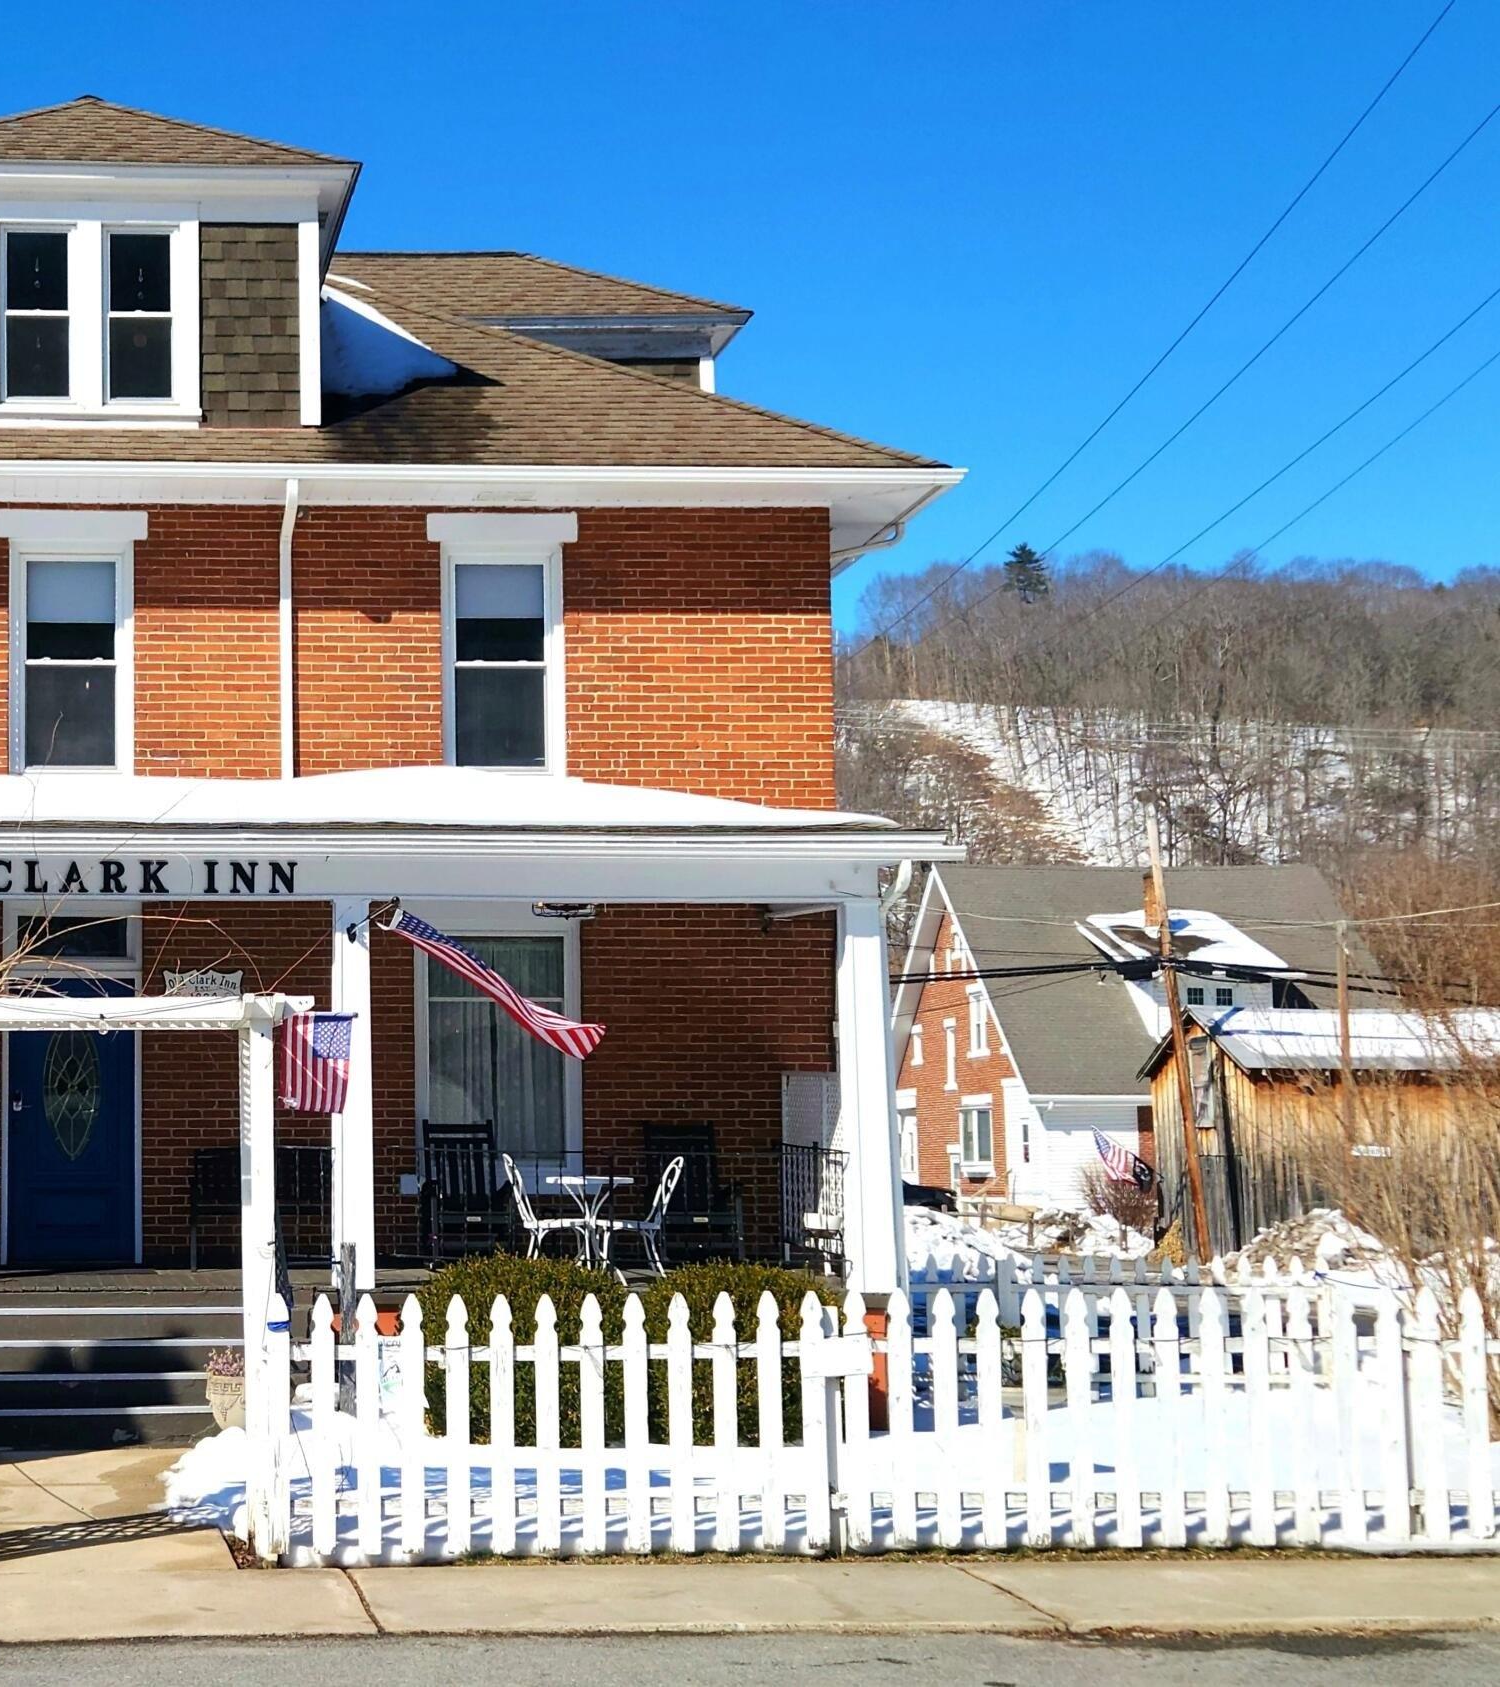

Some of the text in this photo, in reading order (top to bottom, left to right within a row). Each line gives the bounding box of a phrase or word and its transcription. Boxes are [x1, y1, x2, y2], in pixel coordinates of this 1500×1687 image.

[203, 861, 298, 894] INN
[188, 974, 217, 985] Clark
[219, 976, 237, 990] Inn
